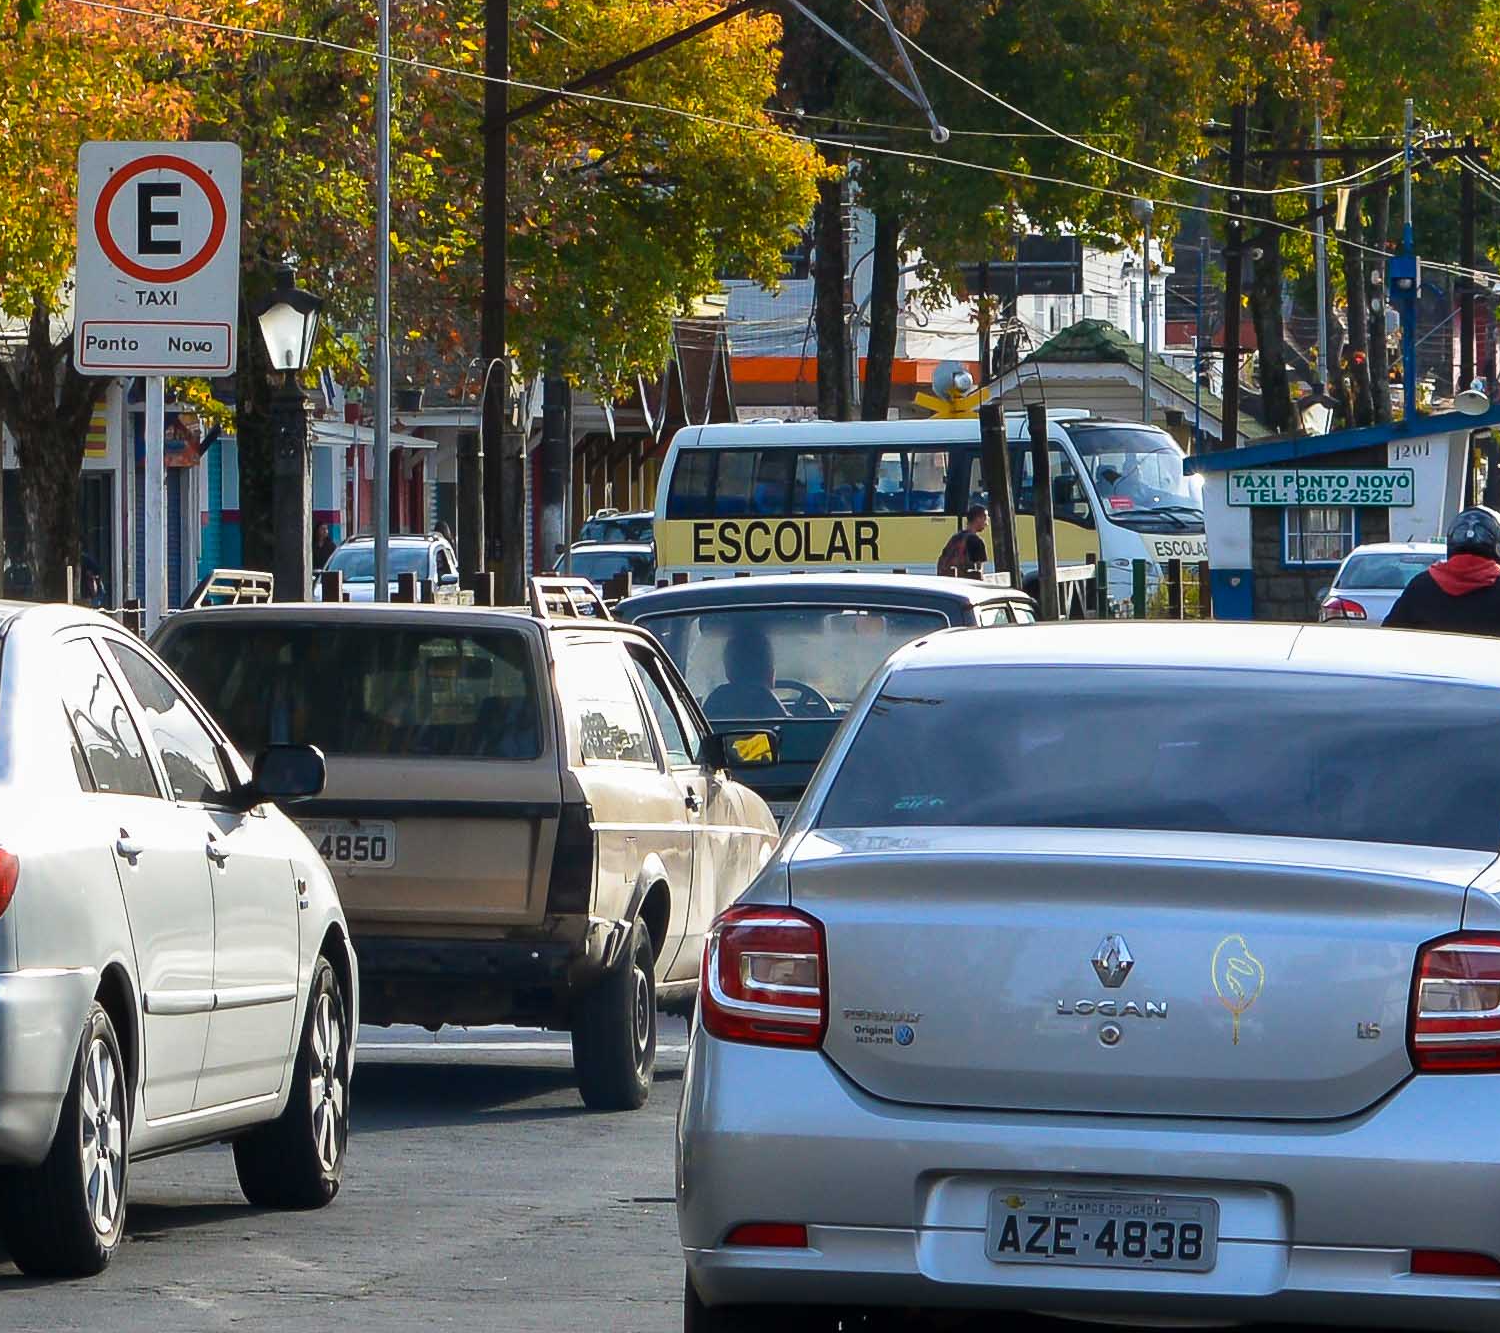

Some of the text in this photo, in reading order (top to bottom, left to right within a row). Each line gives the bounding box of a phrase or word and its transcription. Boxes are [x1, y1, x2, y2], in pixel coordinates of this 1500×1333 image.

[137, 182, 182, 255] E
[135, 290, 178, 306] TAXI
[86, 334, 213, 353] Ponto Novo
[1393, 440, 1431, 461] 1201
[1285, 474, 1350, 489] PONTO
[1247, 489, 1288, 503] TEL:
[692, 519, 881, 564] ESCOLAR
[318, 834, 387, 862] 4850
[1056, 998, 1169, 1019] LOGAN
[854, 1024, 894, 1037] Original
